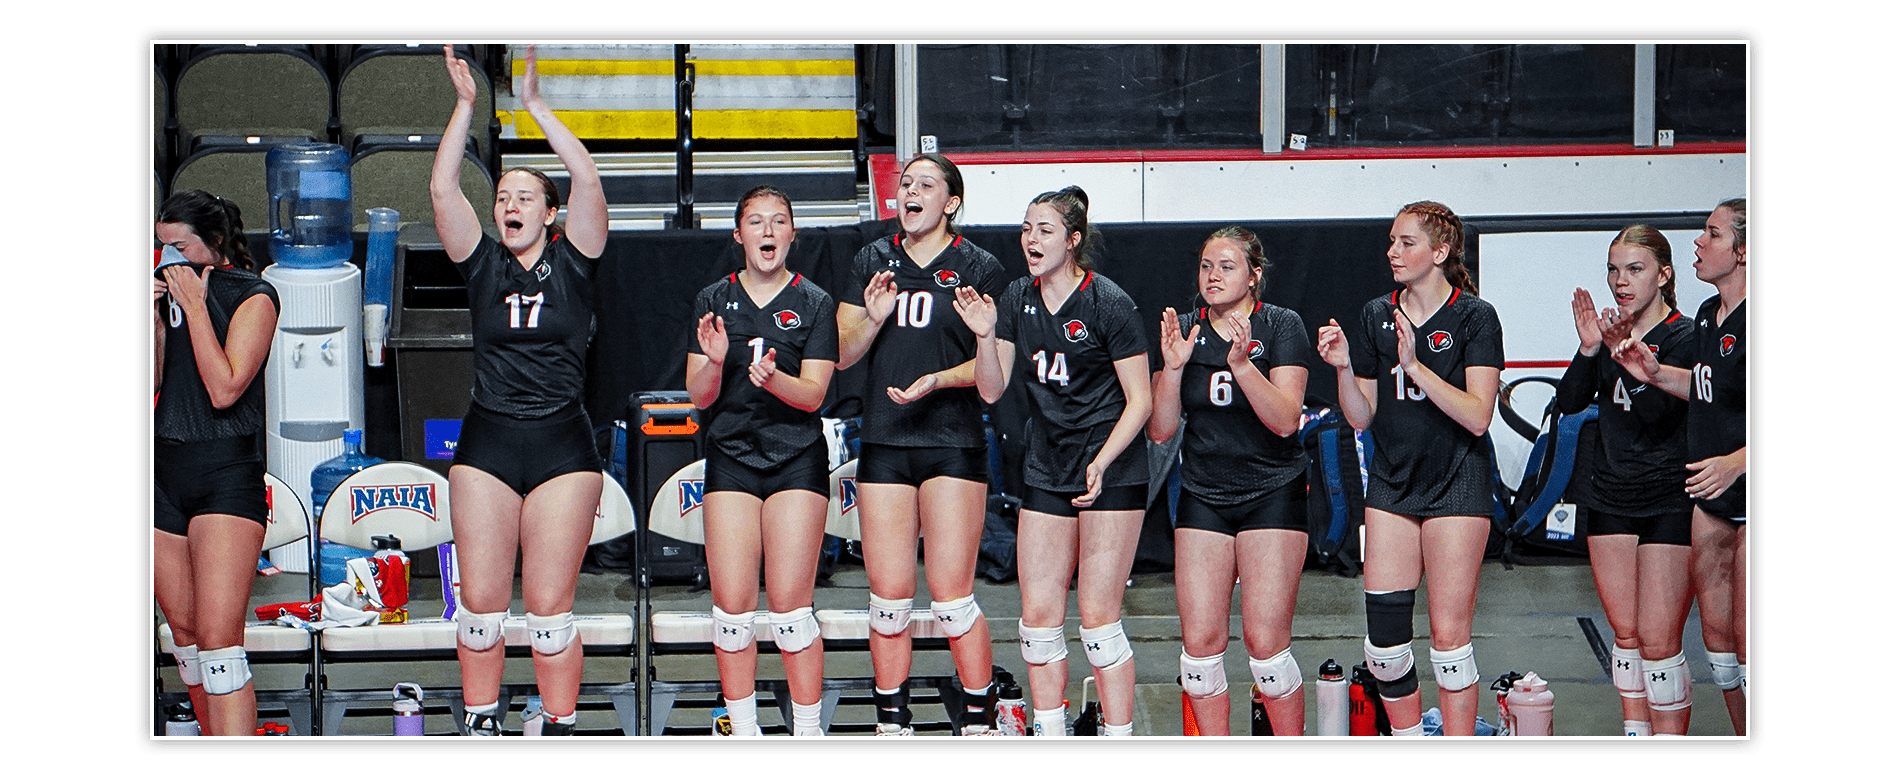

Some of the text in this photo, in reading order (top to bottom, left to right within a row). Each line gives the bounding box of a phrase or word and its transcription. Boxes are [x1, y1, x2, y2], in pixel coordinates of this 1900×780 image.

[504, 291, 544, 328] 17
[895, 290, 934, 328] 10
[747, 336, 764, 365] 1
[1031, 349, 1069, 387] 14
[1209, 370, 1232, 407] 6
[1613, 377, 1632, 411] 4
[1693, 362, 1713, 403] 16
[352, 485, 434, 518] NAIA
